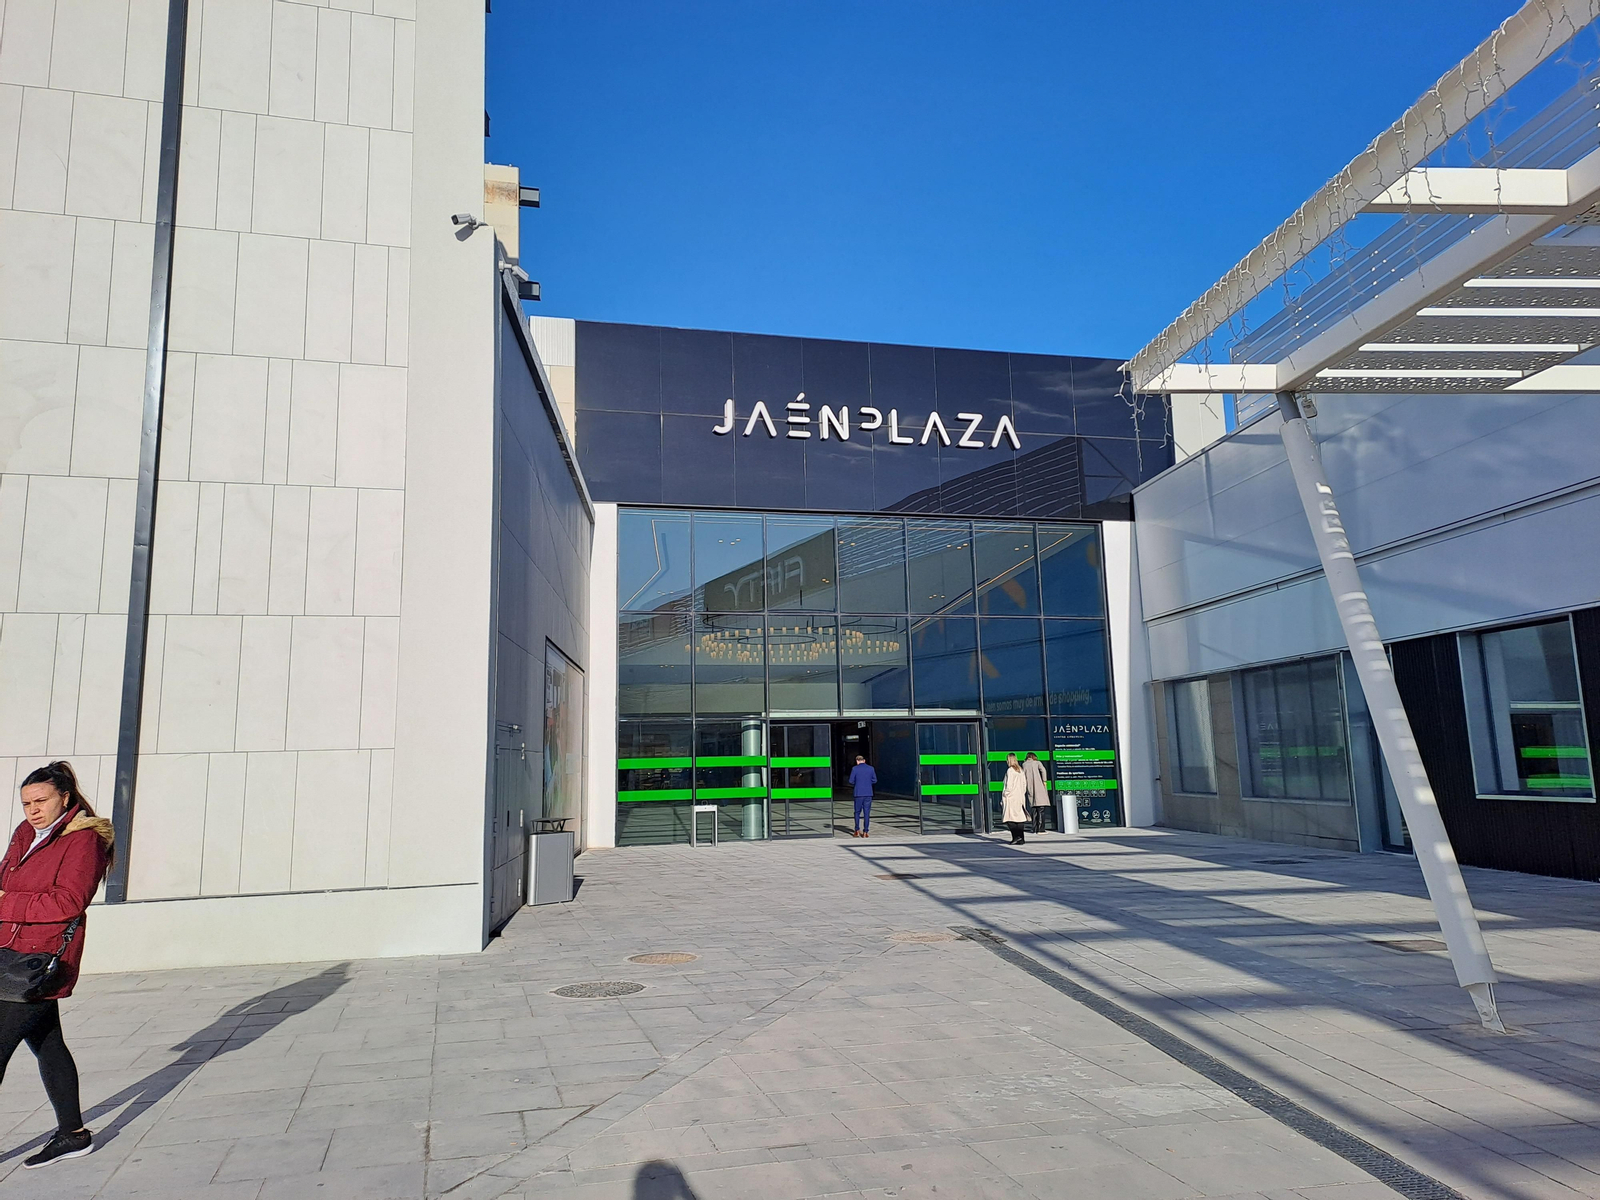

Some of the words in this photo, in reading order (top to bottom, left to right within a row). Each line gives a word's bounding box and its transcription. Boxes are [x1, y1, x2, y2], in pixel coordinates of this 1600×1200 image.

[712, 392, 1022, 450] JAÉNPLAZA
[996, 700, 1012, 712] somos
[1013, 698, 1025, 712] muy
[1025, 694, 1033, 708] de
[1049, 691, 1057, 706] de
[1053, 723, 1110, 733] JAÉNPLAZA
